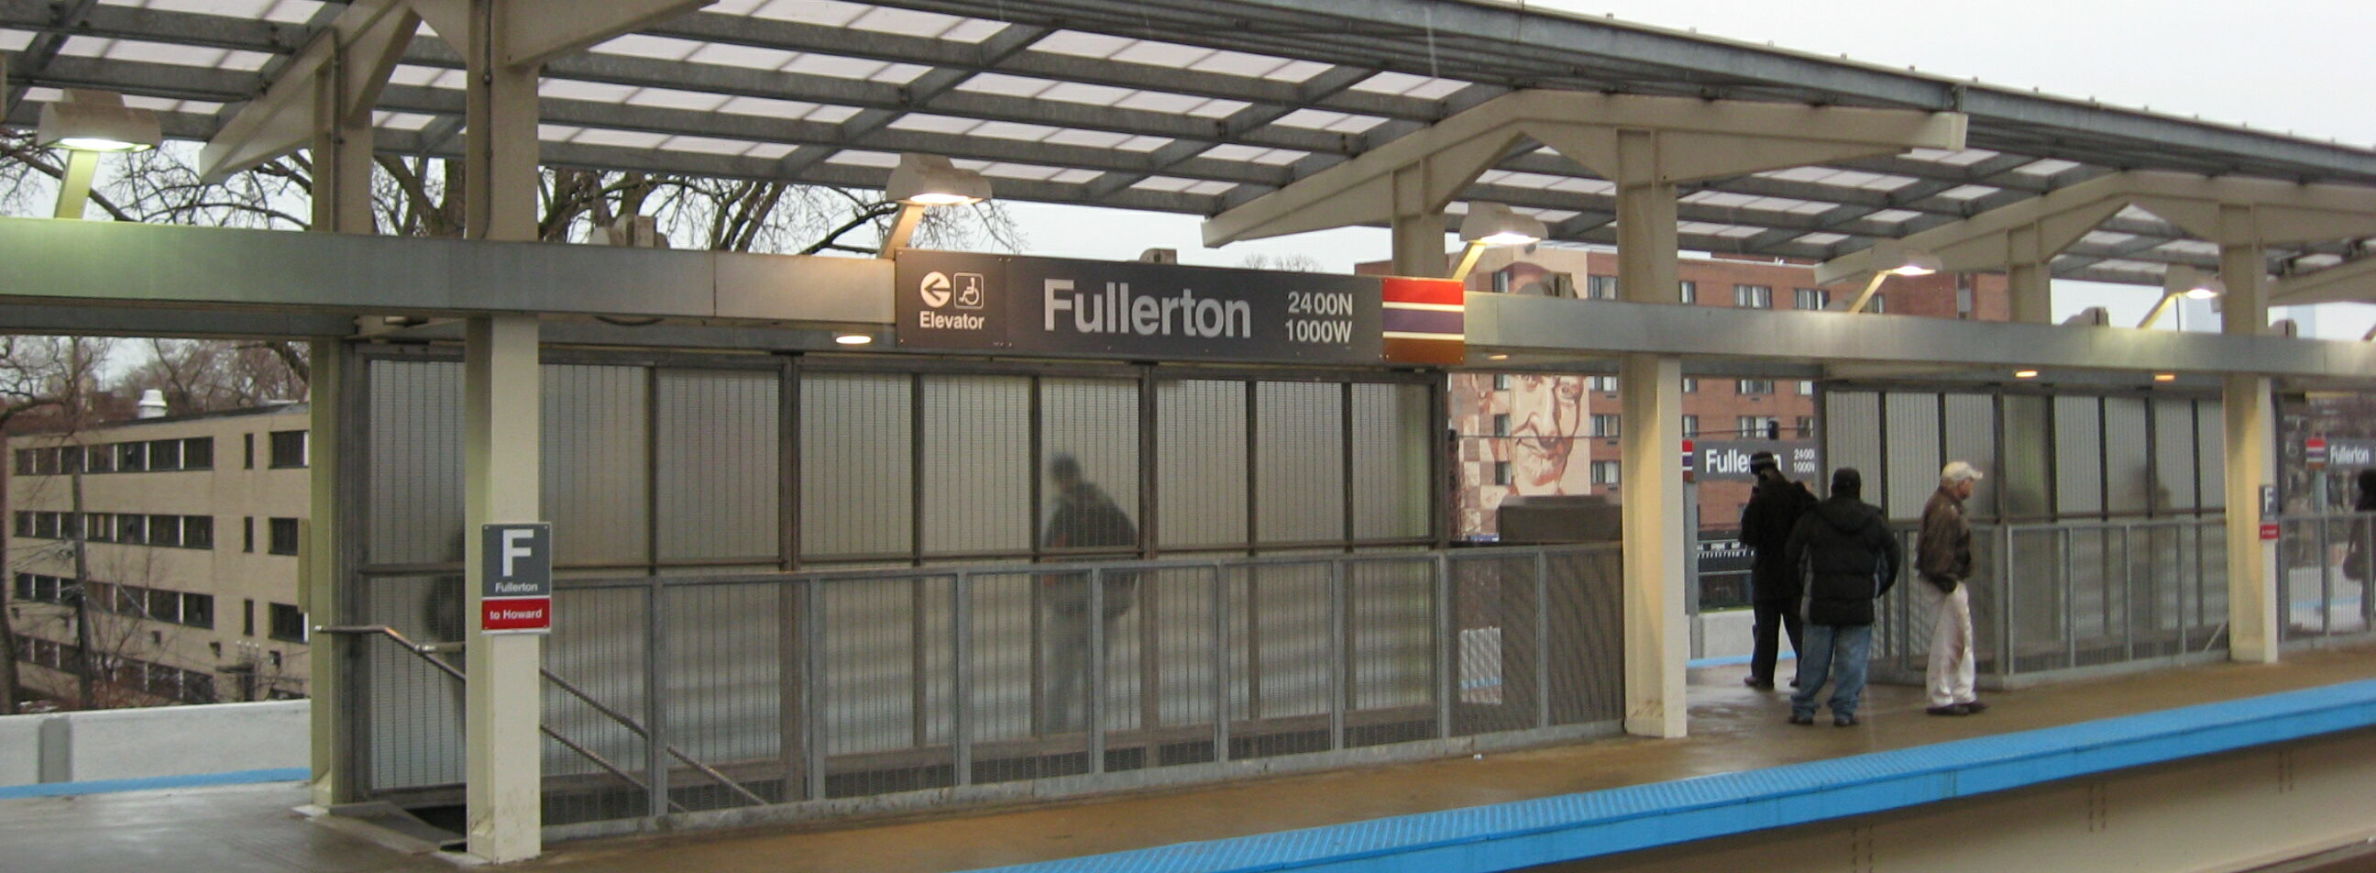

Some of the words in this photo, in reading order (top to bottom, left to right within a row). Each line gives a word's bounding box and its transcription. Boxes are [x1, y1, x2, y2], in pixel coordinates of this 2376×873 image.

[1043, 278, 1252, 338] Fullerton
[1287, 290, 1353, 316] 2400N
[919, 310, 985, 329] Elevator
[1285, 318, 1353, 343] 1000W
[1706, 449, 1782, 473] Fullen
[2330, 445, 2369, 464] Fullerton
[2264, 487, 2274, 512] F
[503, 529, 534, 577] F
[495, 582, 539, 592] Fullerton
[490, 611, 500, 620] to
[503, 608, 542, 619] Howard
